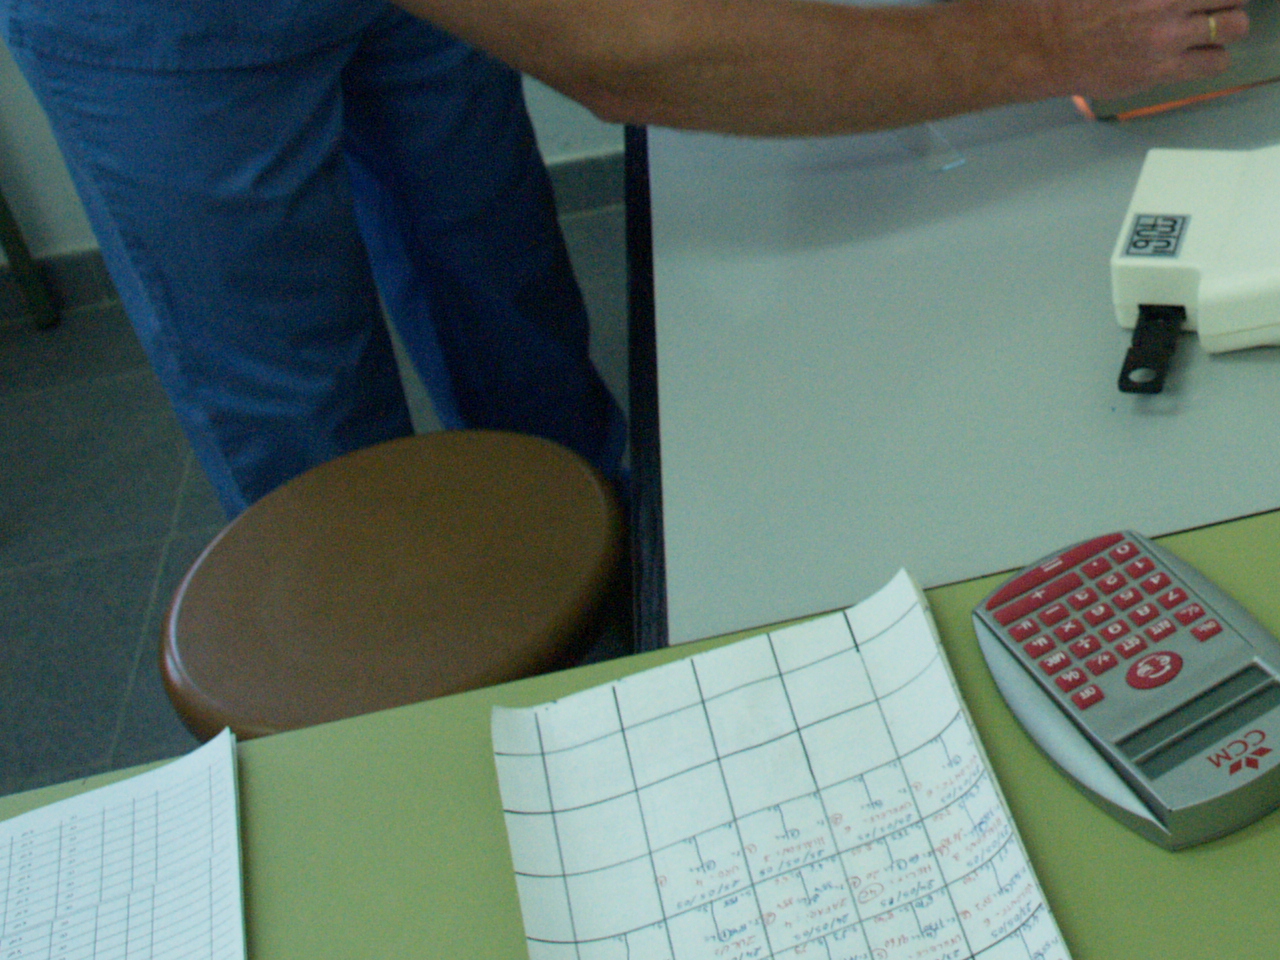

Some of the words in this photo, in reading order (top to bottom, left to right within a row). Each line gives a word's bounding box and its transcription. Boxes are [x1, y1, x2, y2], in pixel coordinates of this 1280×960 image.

[1115, 543, 1131, 555] 0
[1134, 560, 1145, 569] 1
[1105, 574, 1119, 586] 2
[1148, 574, 1161, 585] 4
[1119, 589, 1134, 601] 5
[1167, 590, 1180, 602] 7
[1136, 604, 1151, 616] 8
[1107, 622, 1123, 635] 9
[1206, 729, 1267, 769] CCM
